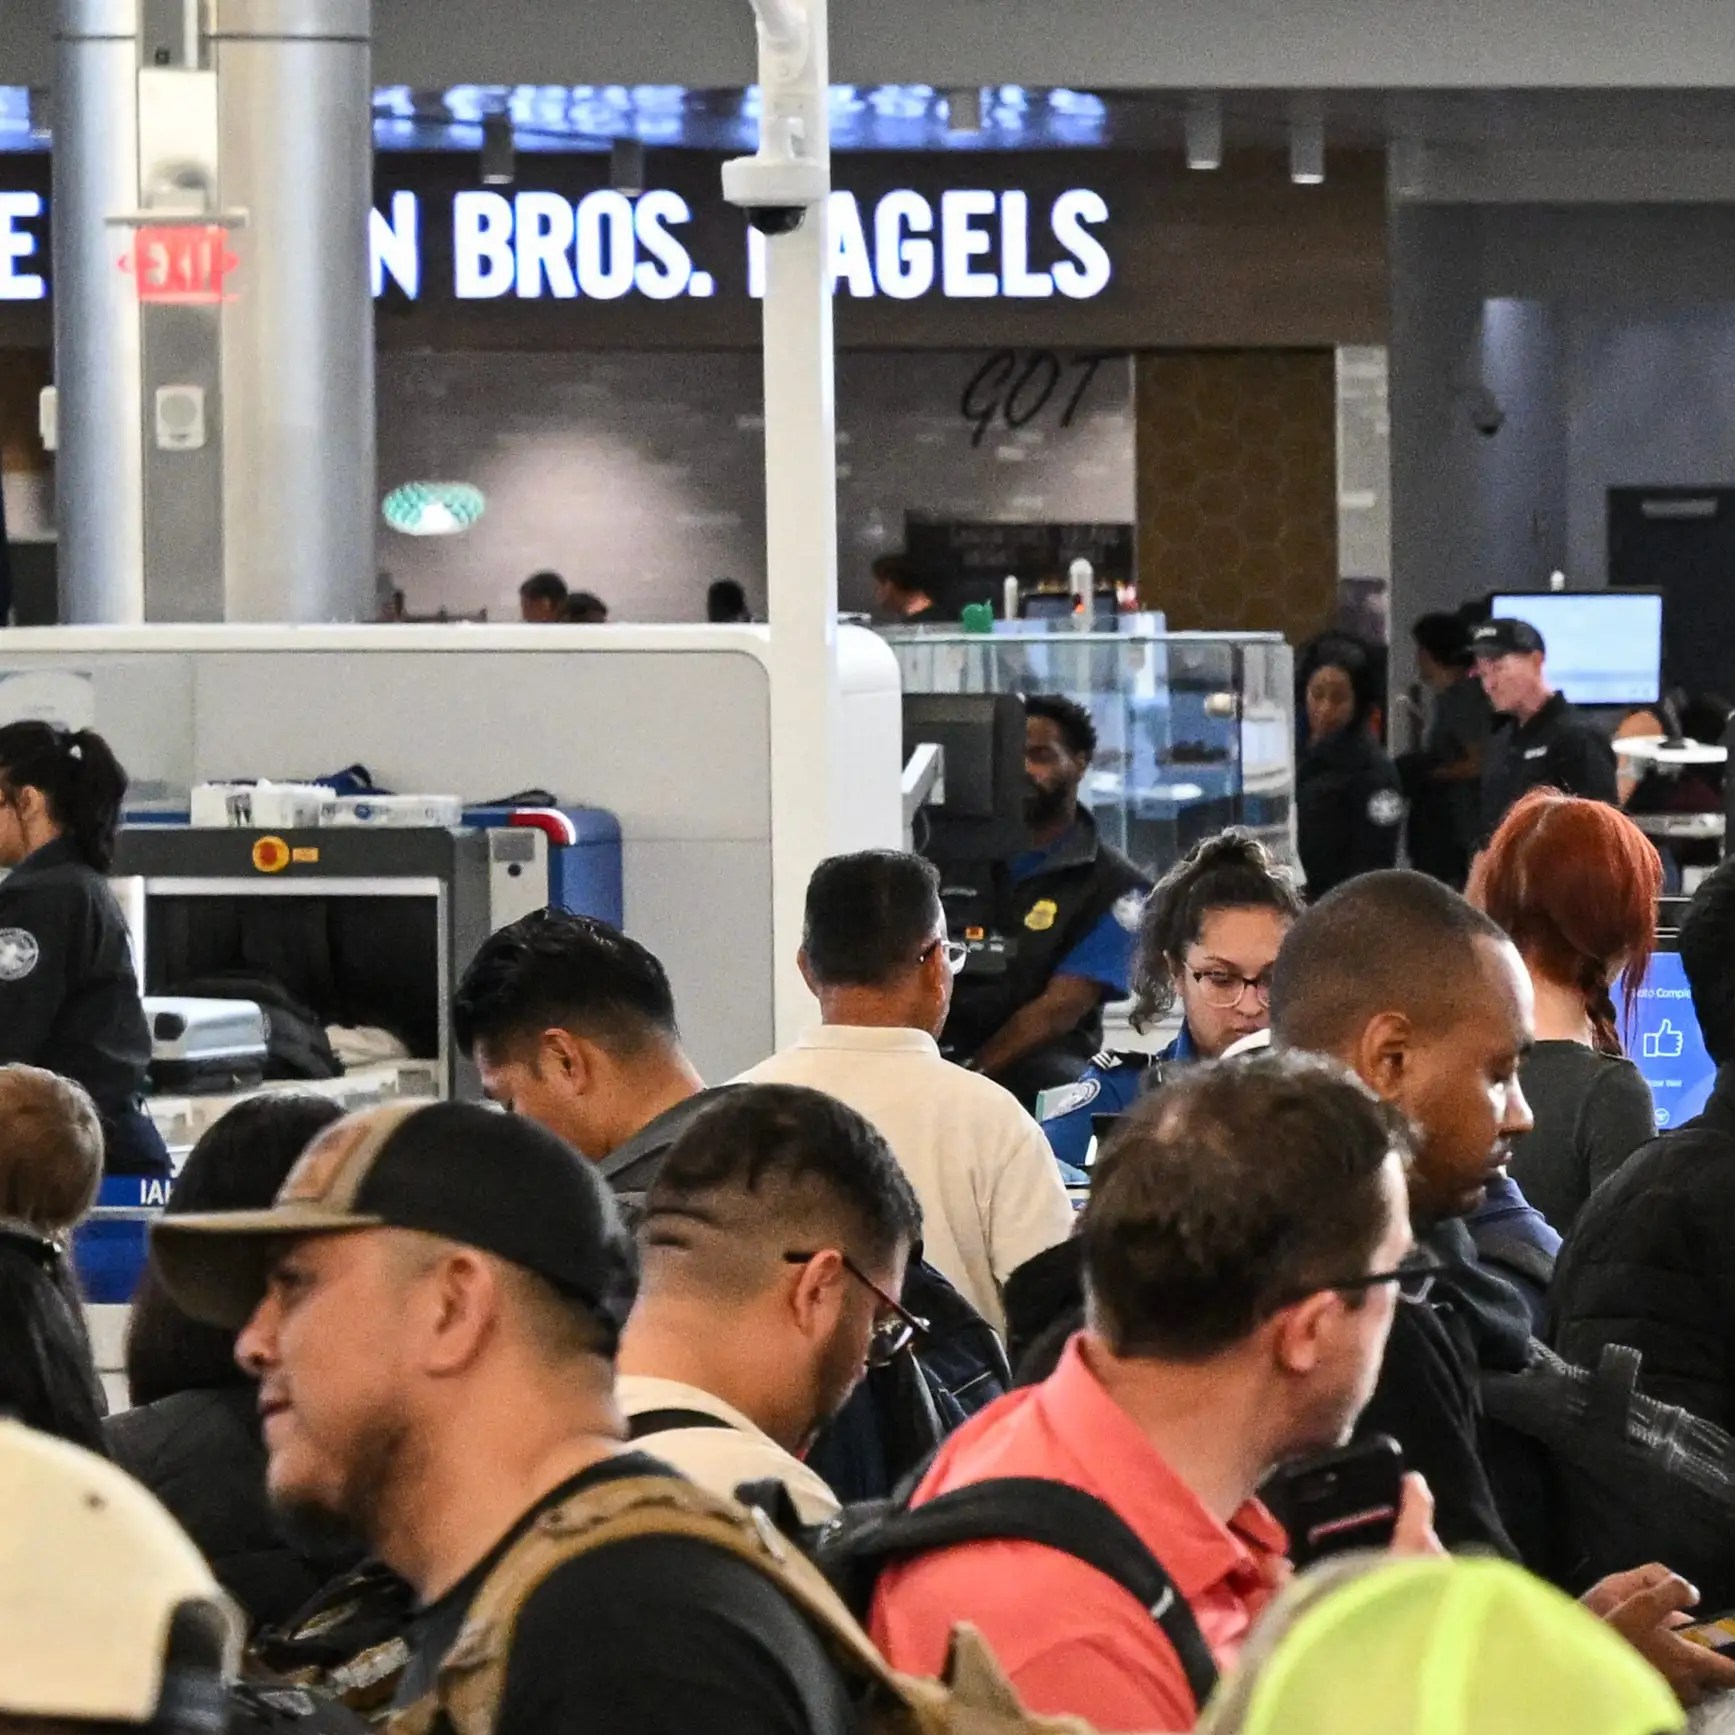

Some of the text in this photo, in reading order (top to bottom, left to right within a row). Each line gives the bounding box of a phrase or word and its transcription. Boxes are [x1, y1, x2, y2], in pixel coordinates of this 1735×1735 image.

[454, 189, 714, 299] BROS.
[748, 189, 1112, 299] AGELS
[962, 350, 1122, 448] GOT
